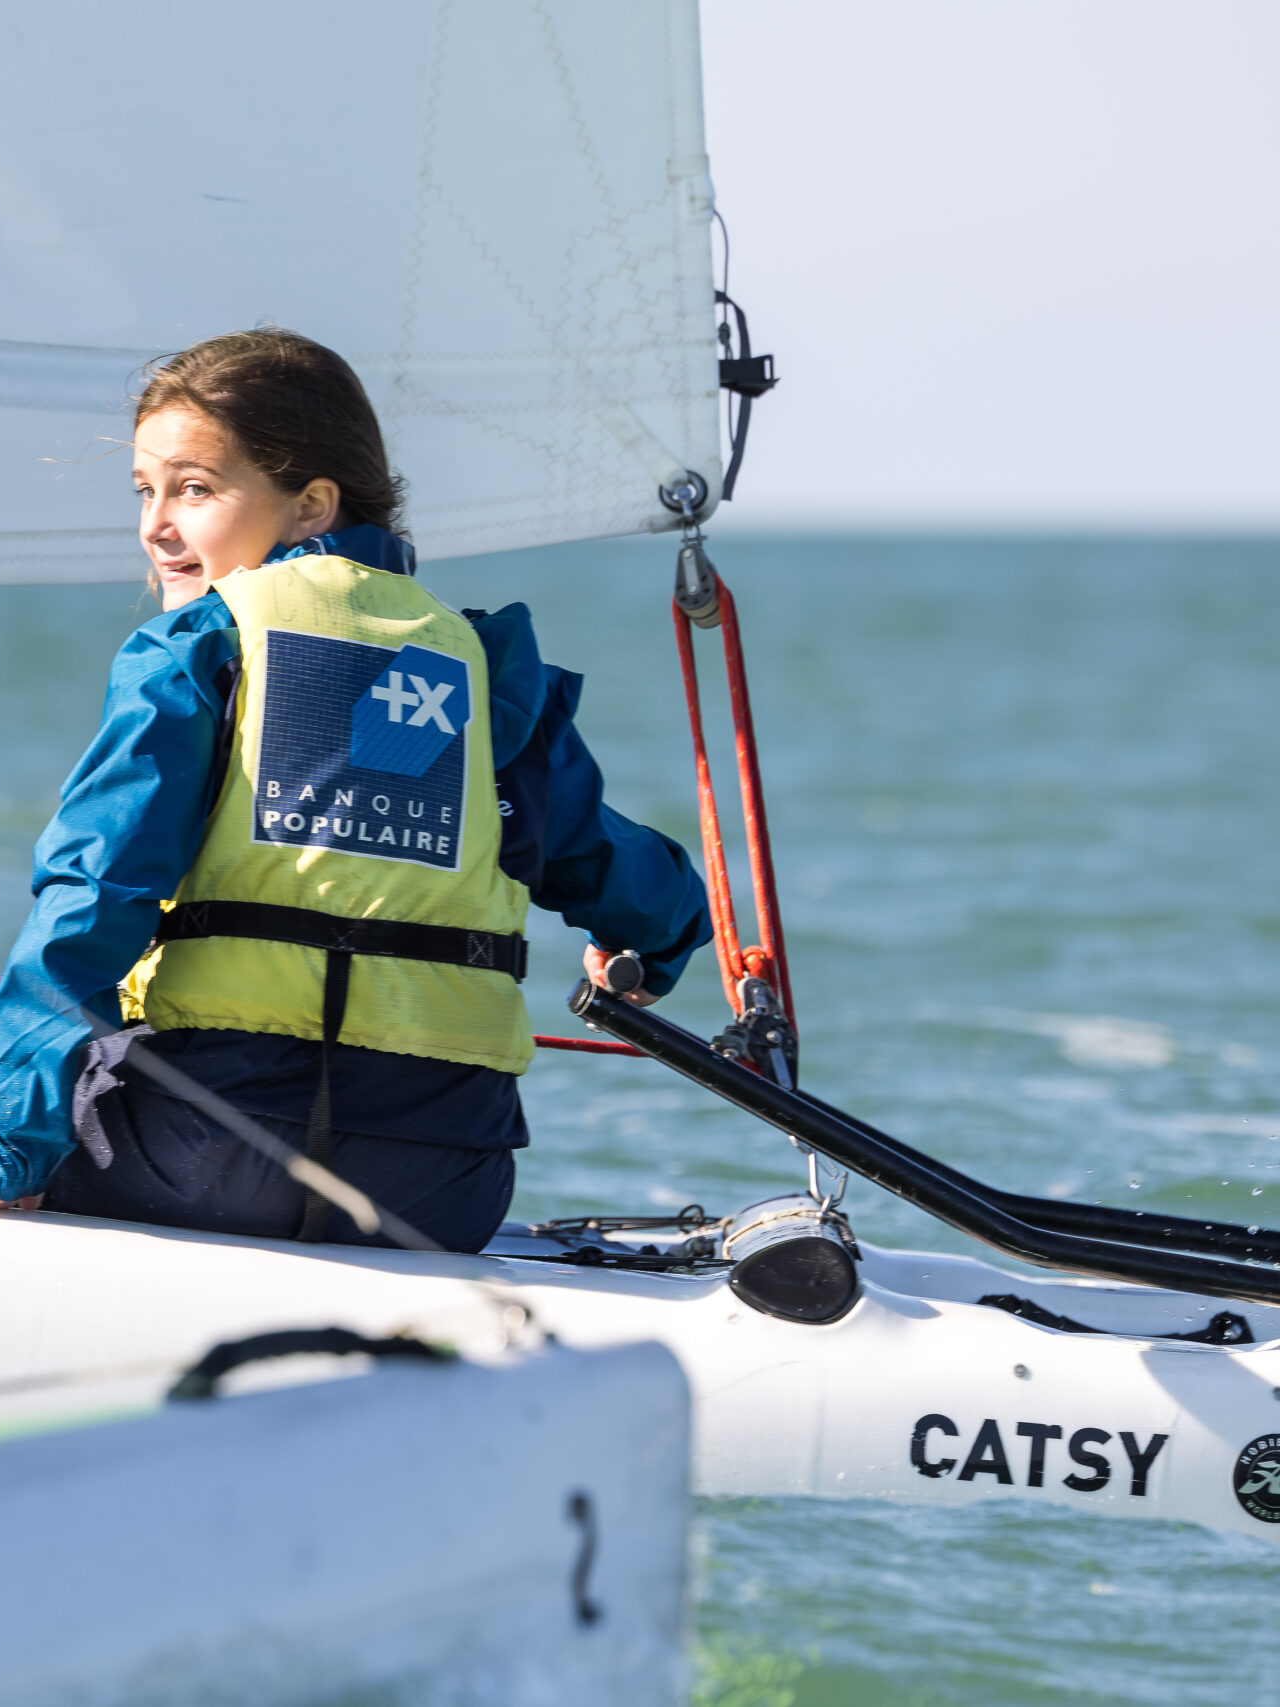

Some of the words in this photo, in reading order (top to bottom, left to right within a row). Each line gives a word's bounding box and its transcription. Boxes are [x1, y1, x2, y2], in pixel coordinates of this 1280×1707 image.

[266, 780, 453, 825] BANQUE
[263, 809, 451, 855] POPULAIRE
[910, 1412, 1170, 1497] CATSY
